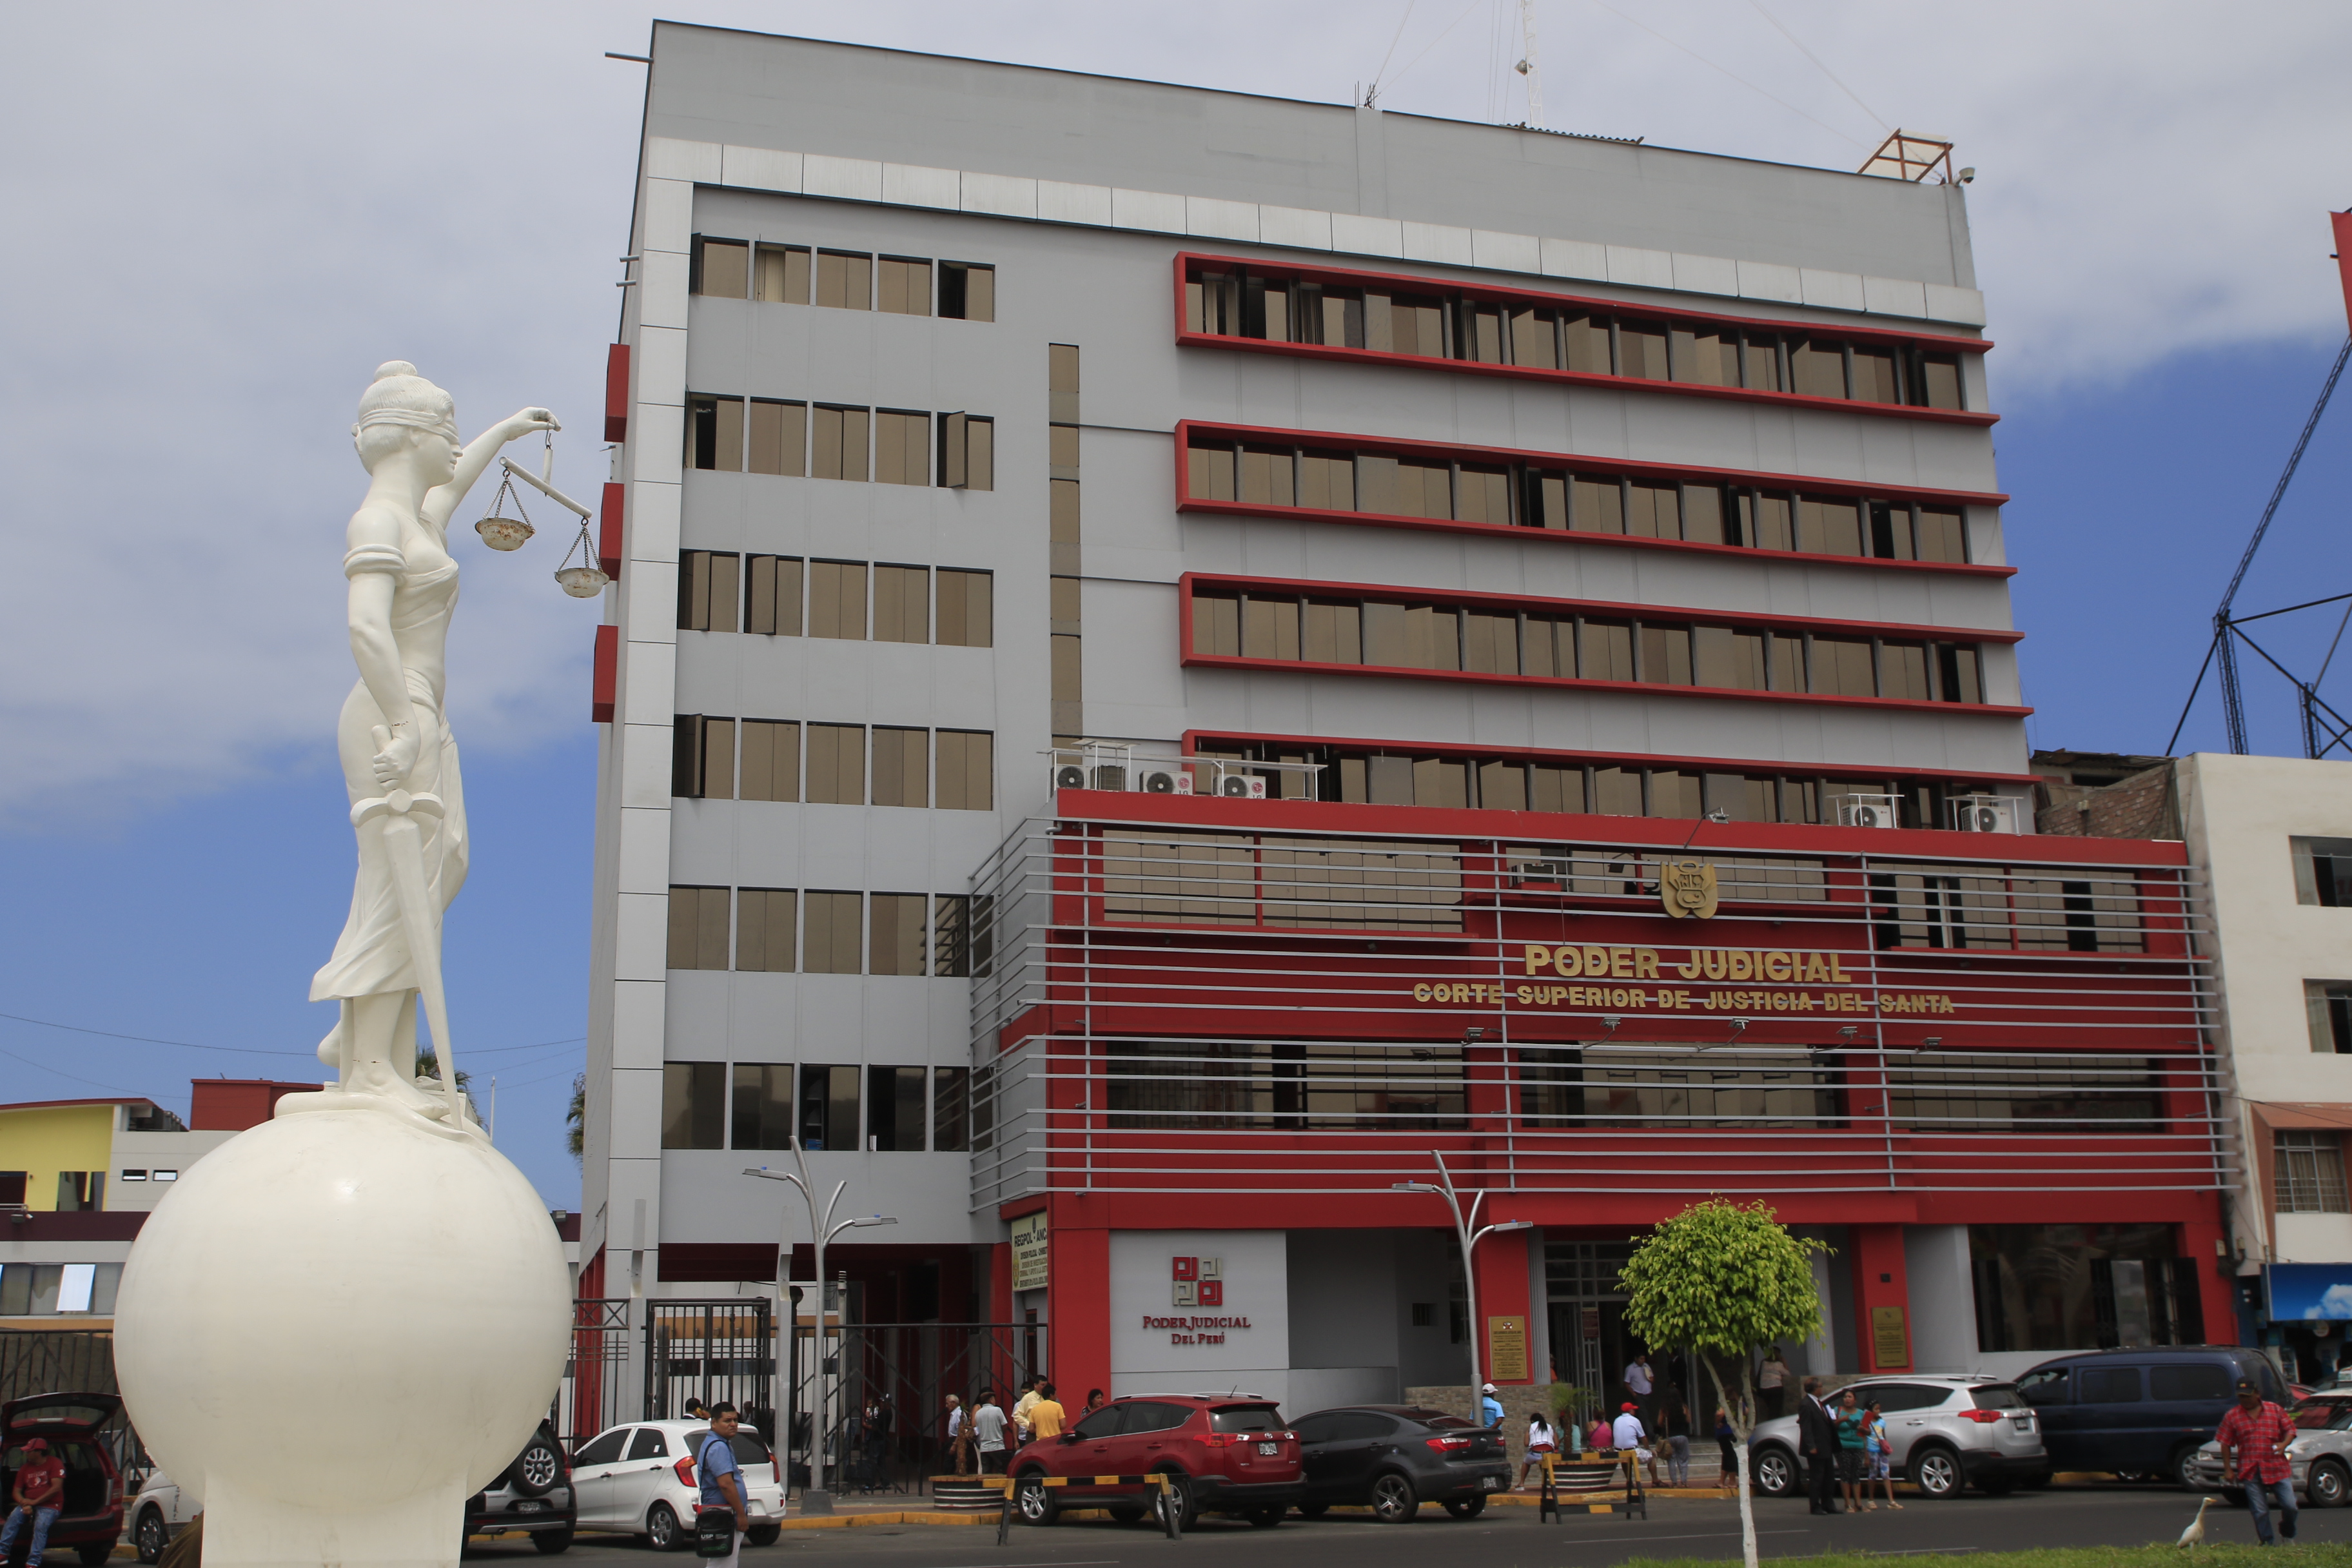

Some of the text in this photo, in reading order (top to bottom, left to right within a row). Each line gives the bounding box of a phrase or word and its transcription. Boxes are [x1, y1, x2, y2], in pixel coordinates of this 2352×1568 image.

[1525, 945, 1851, 983] PODER JUDICIAL
[1413, 983, 1954, 1013] CORTE SUPERIOR DE JUSTICIA DEL SANTA
[1014, 1232, 1032, 1247] REGPOL
[1036, 1228, 1047, 1242] ANC
[1143, 1316, 1251, 1331] PODER JUDICIAL
[1171, 1331, 1225, 1344] DEL PERÚ
